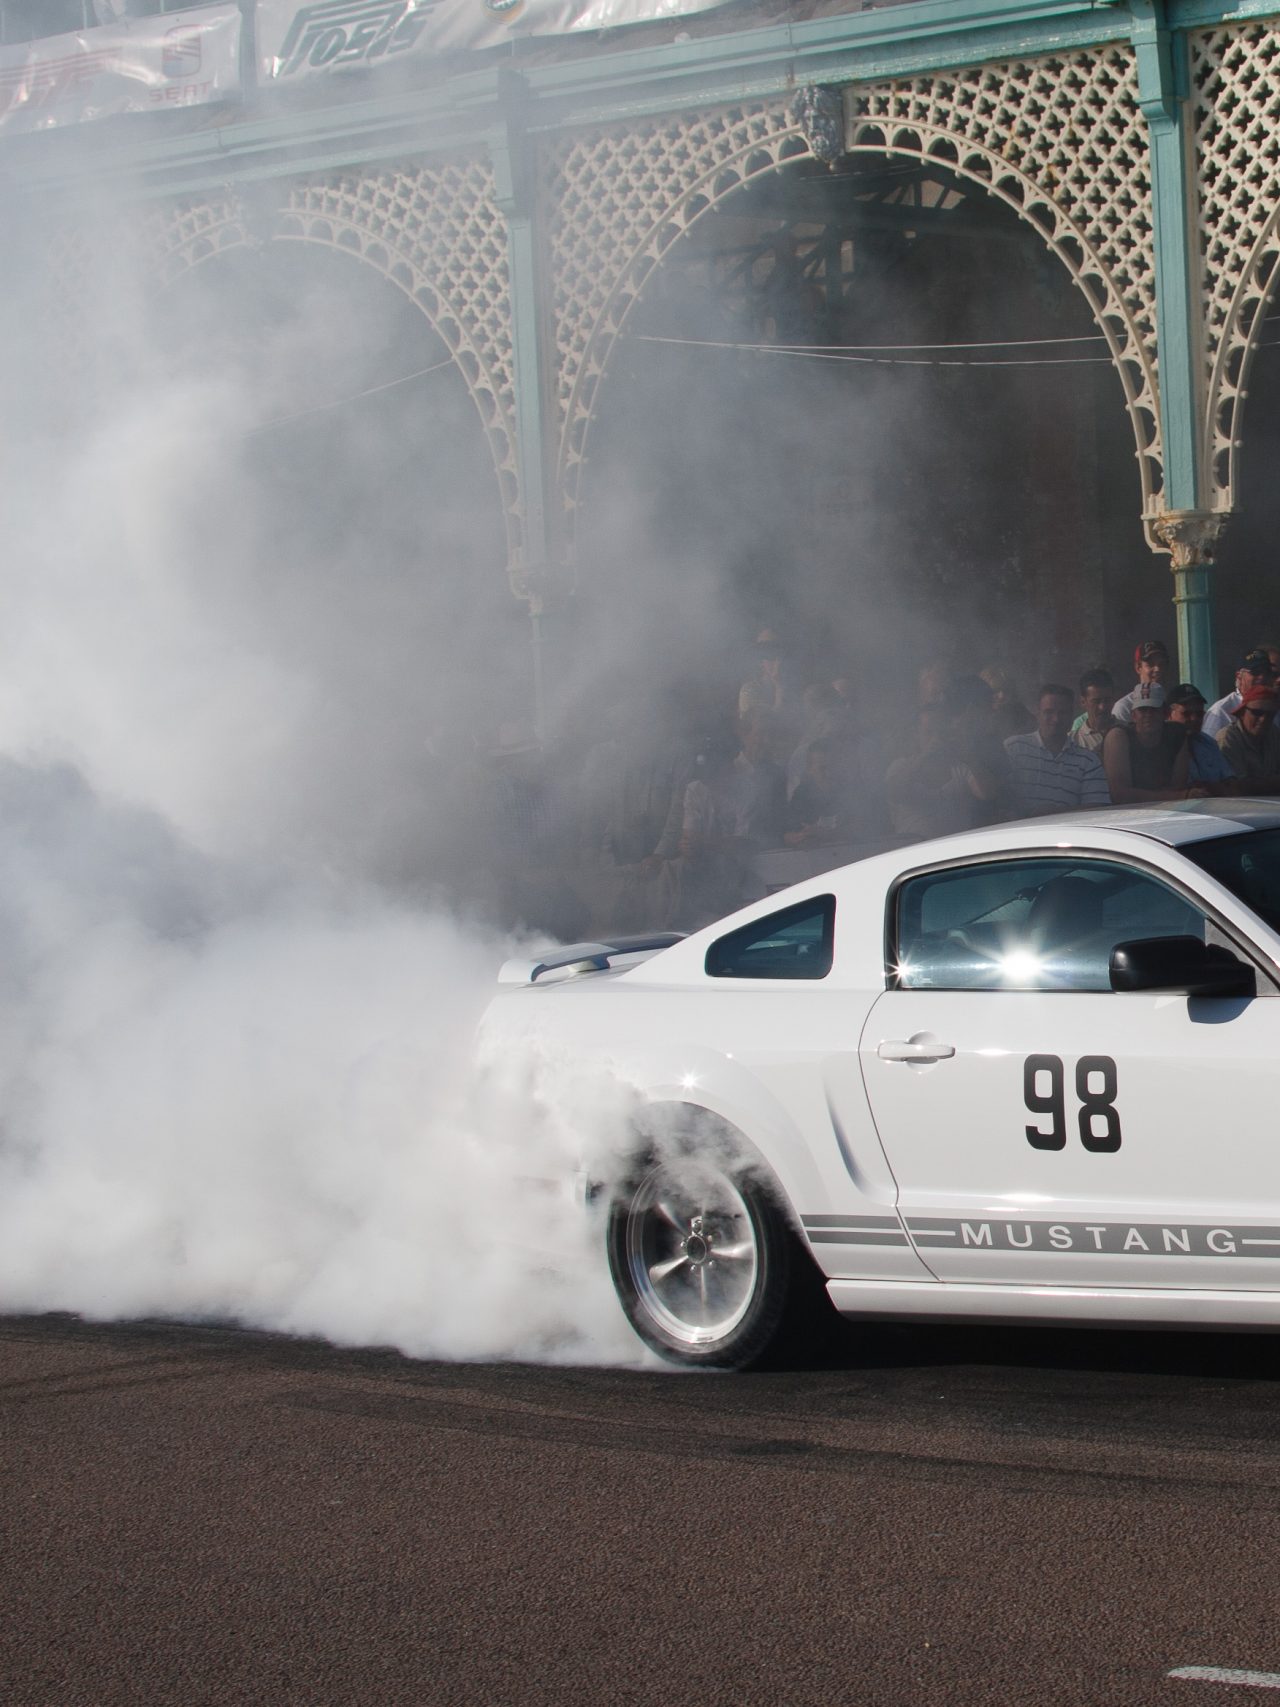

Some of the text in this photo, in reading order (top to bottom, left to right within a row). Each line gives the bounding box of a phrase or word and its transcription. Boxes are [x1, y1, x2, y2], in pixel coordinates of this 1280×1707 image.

[149, 81, 212, 102] SEAT
[1024, 1054, 1121, 1153] 98
[960, 1222, 1237, 1253] MUSTANG
